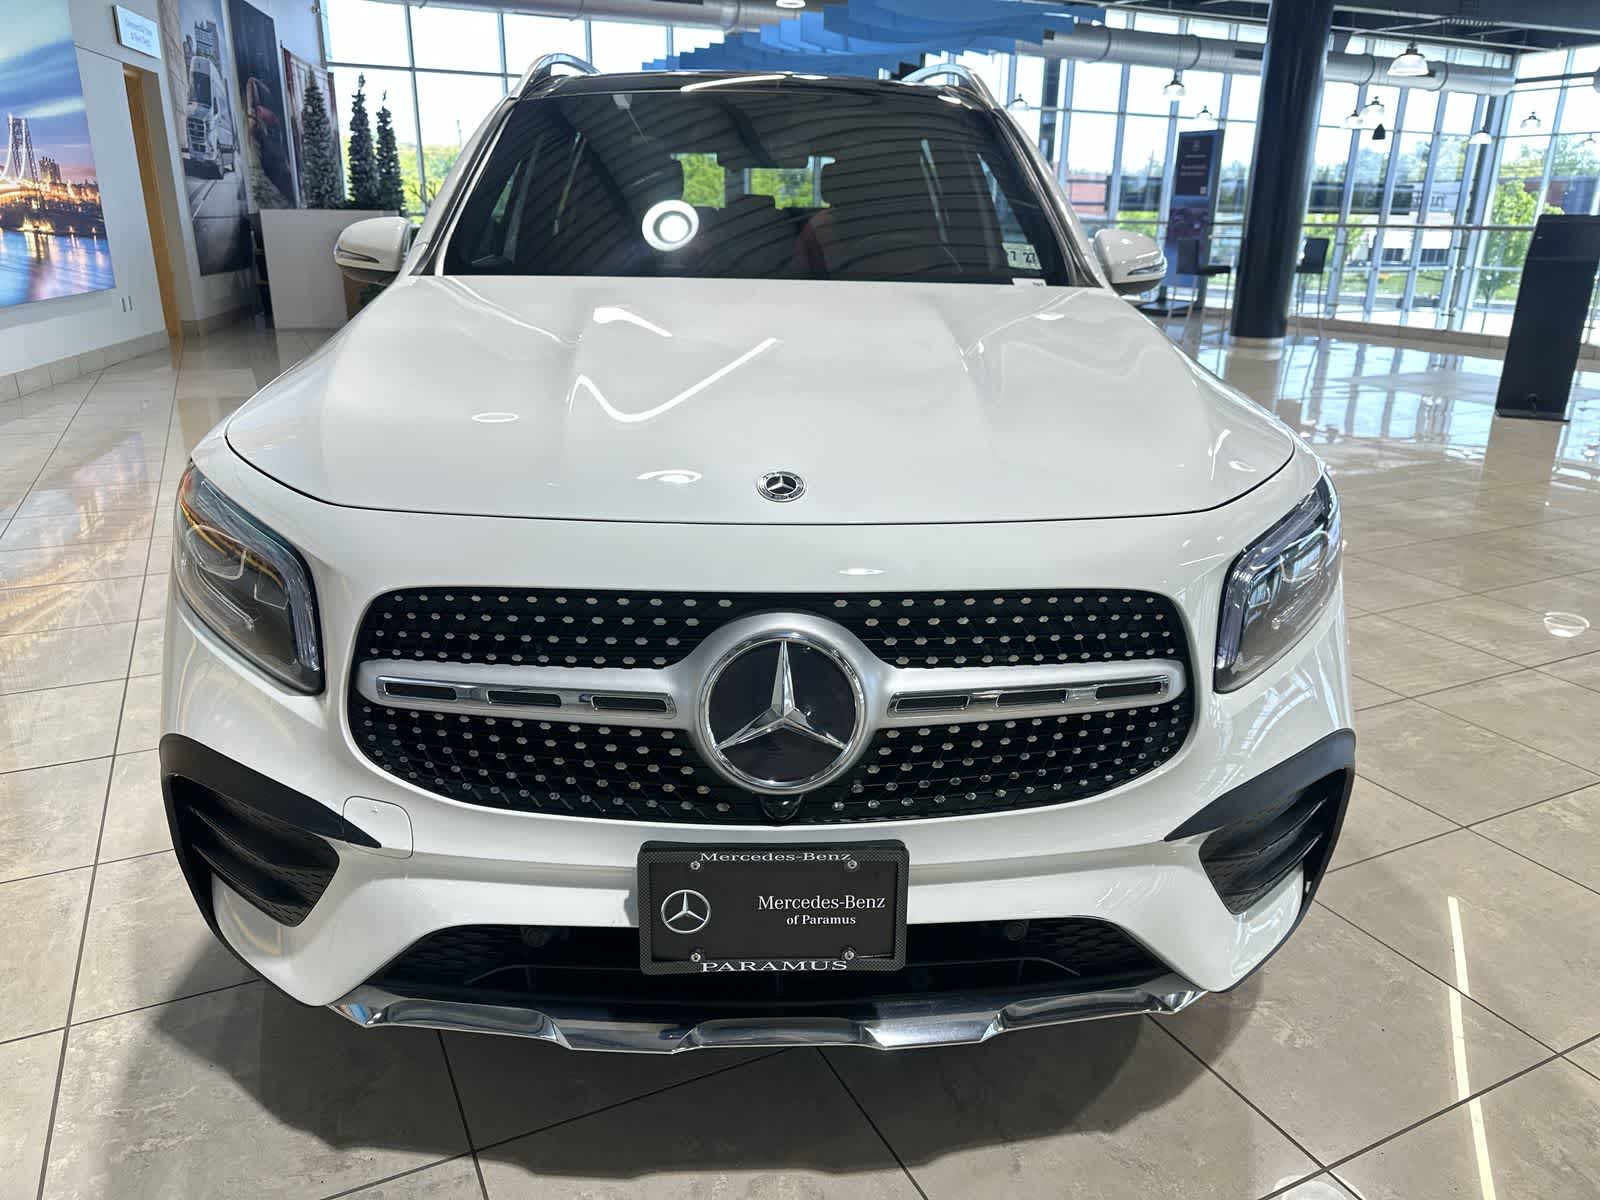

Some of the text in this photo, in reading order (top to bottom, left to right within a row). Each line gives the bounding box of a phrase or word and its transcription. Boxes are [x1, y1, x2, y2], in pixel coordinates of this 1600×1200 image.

[700, 852, 852, 862] Mercedes-Benz
[758, 895, 886, 910] Mercedes-Benz
[786, 914, 856, 925] of Paramus
[701, 960, 848, 972] PARAMUS
